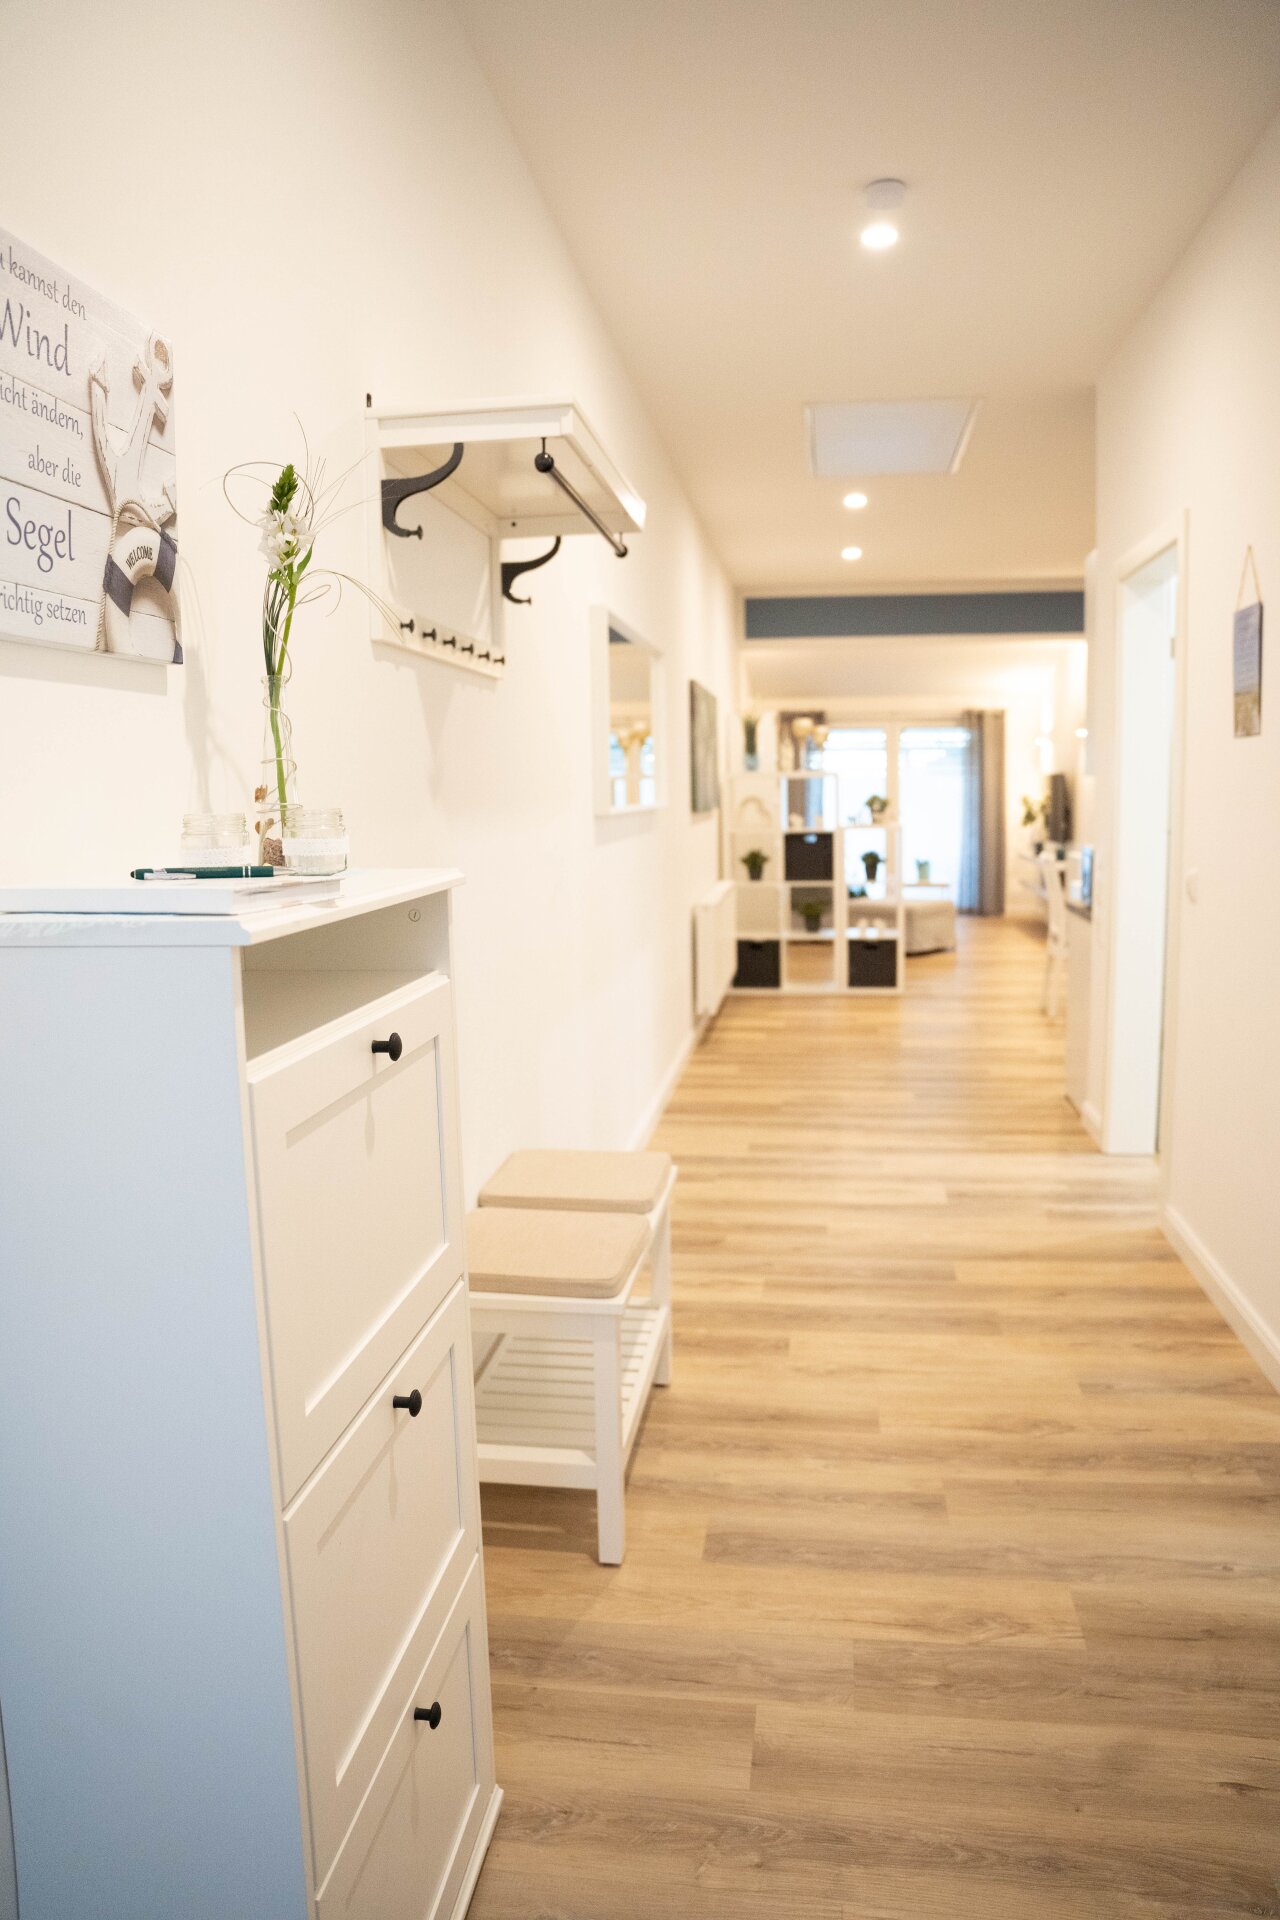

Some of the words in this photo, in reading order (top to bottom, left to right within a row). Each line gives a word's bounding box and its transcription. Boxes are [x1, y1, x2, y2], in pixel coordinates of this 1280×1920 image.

[9, 246, 59, 304] kannst
[62, 284, 87, 320] den
[0, 298, 71, 376] Wind
[31, 391, 84, 438] ändern,
[28, 444, 59, 478] aber
[62, 457, 82, 487] die
[6, 497, 75, 573] Segel
[125, 545, 154, 570] WELCOME
[46, 600, 88, 625] setzen
